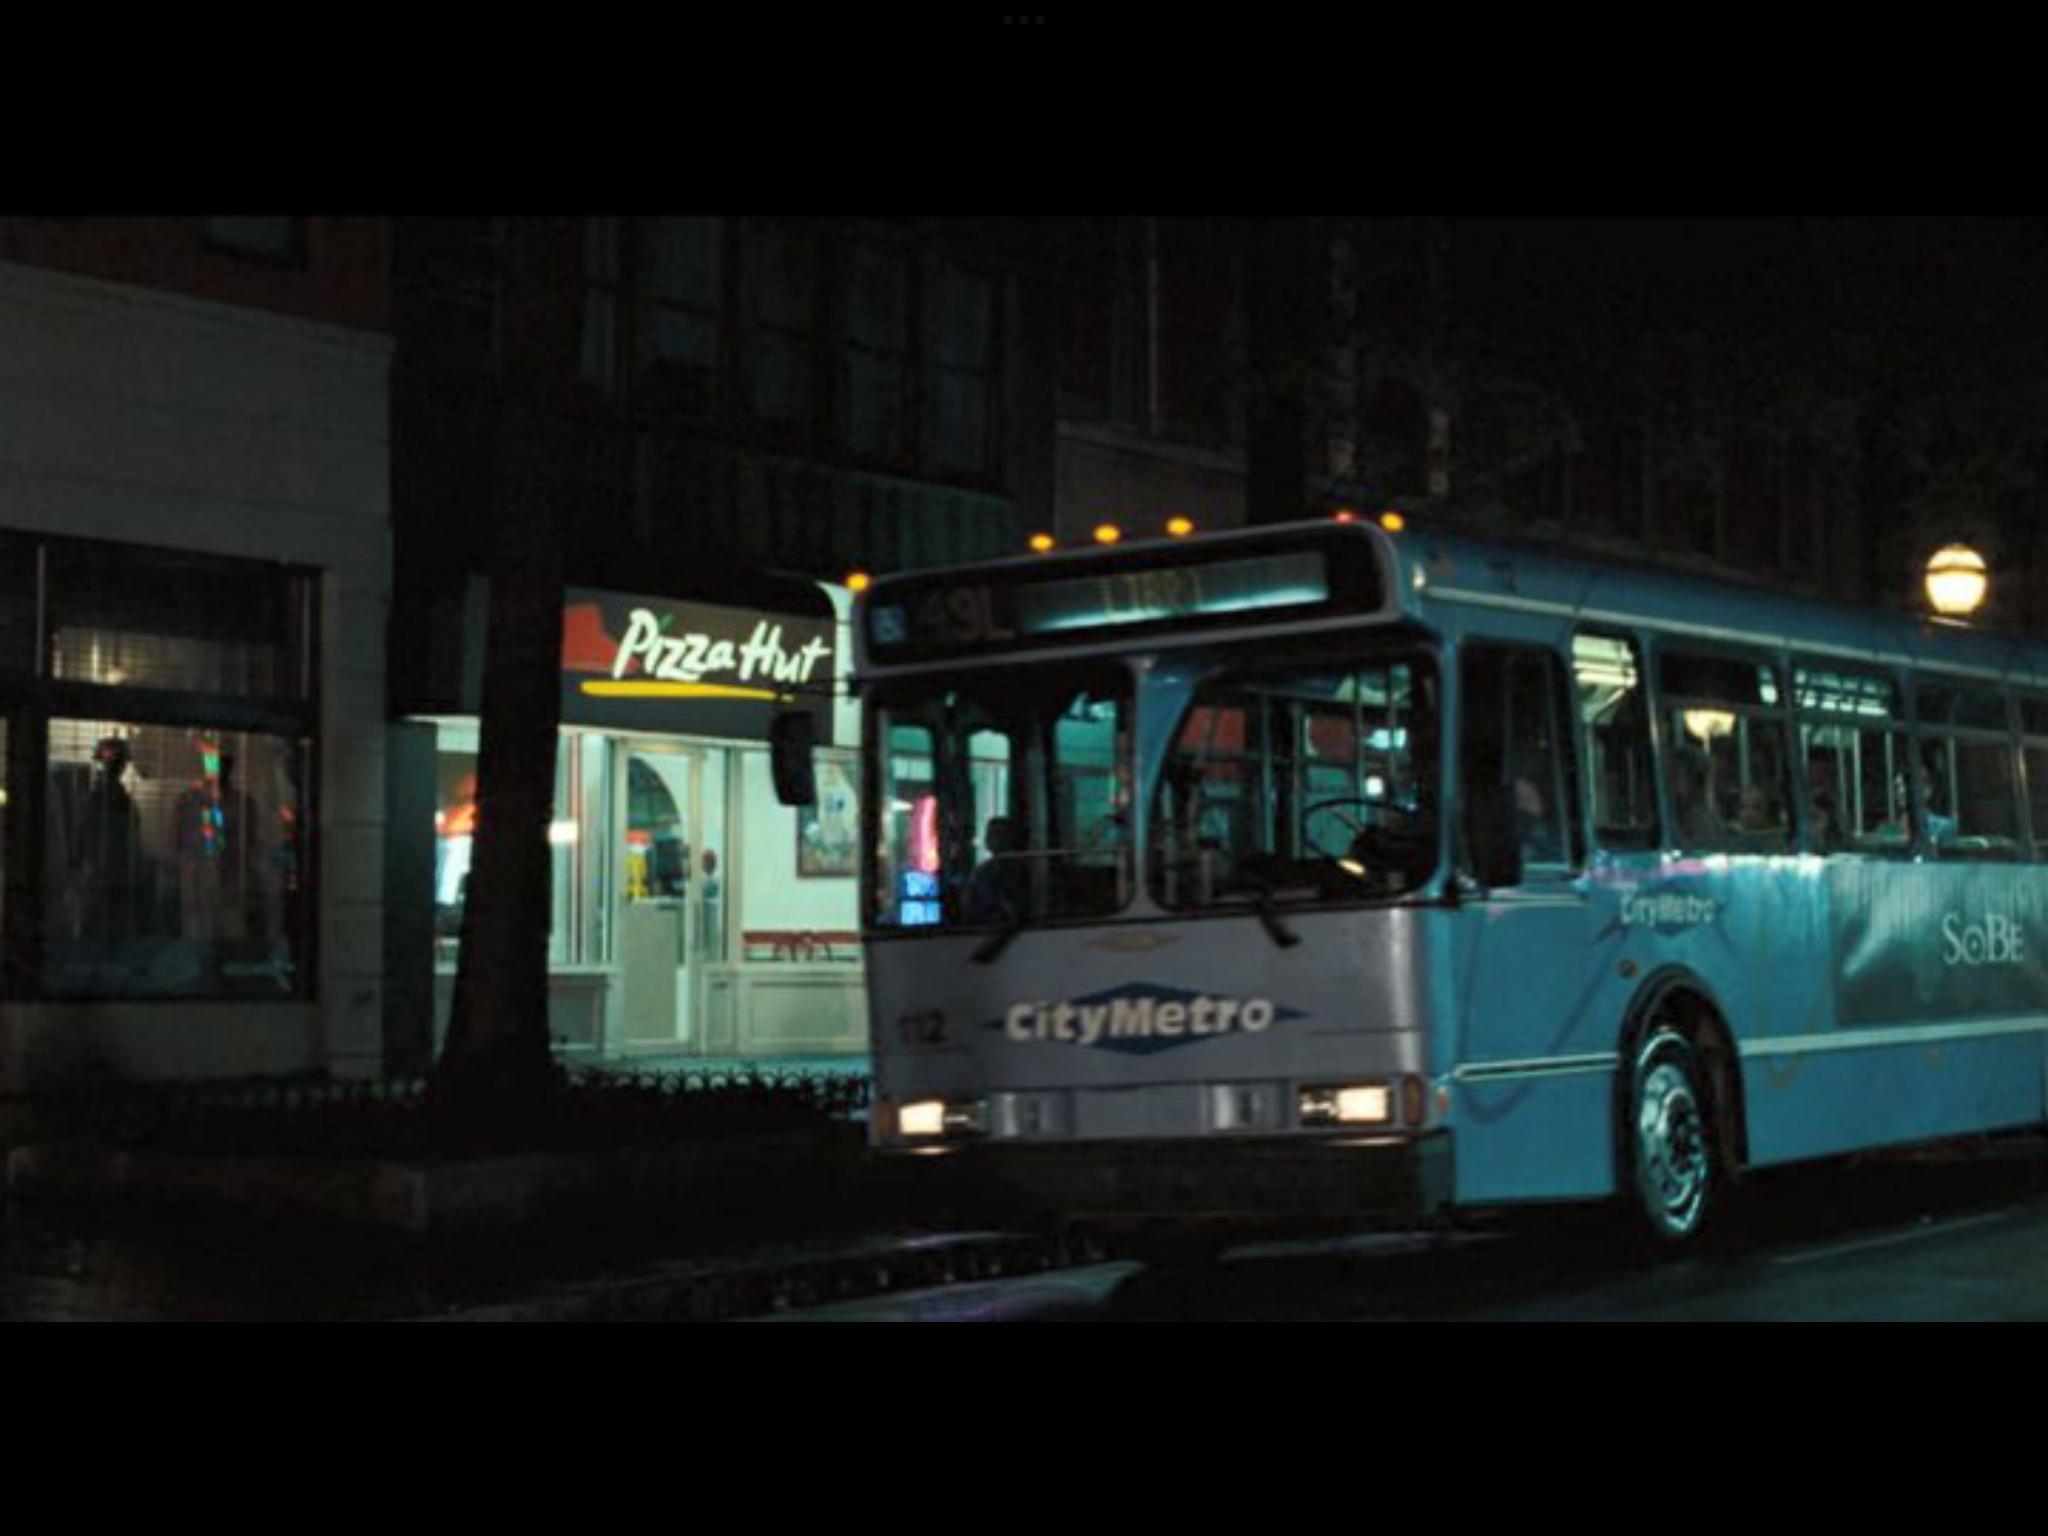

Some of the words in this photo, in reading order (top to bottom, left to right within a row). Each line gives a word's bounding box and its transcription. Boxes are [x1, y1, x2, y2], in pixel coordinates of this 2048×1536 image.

[612, 607, 735, 682] Pizza
[738, 619, 831, 683] Hut
[1005, 997, 1272, 1045] CityMetro
